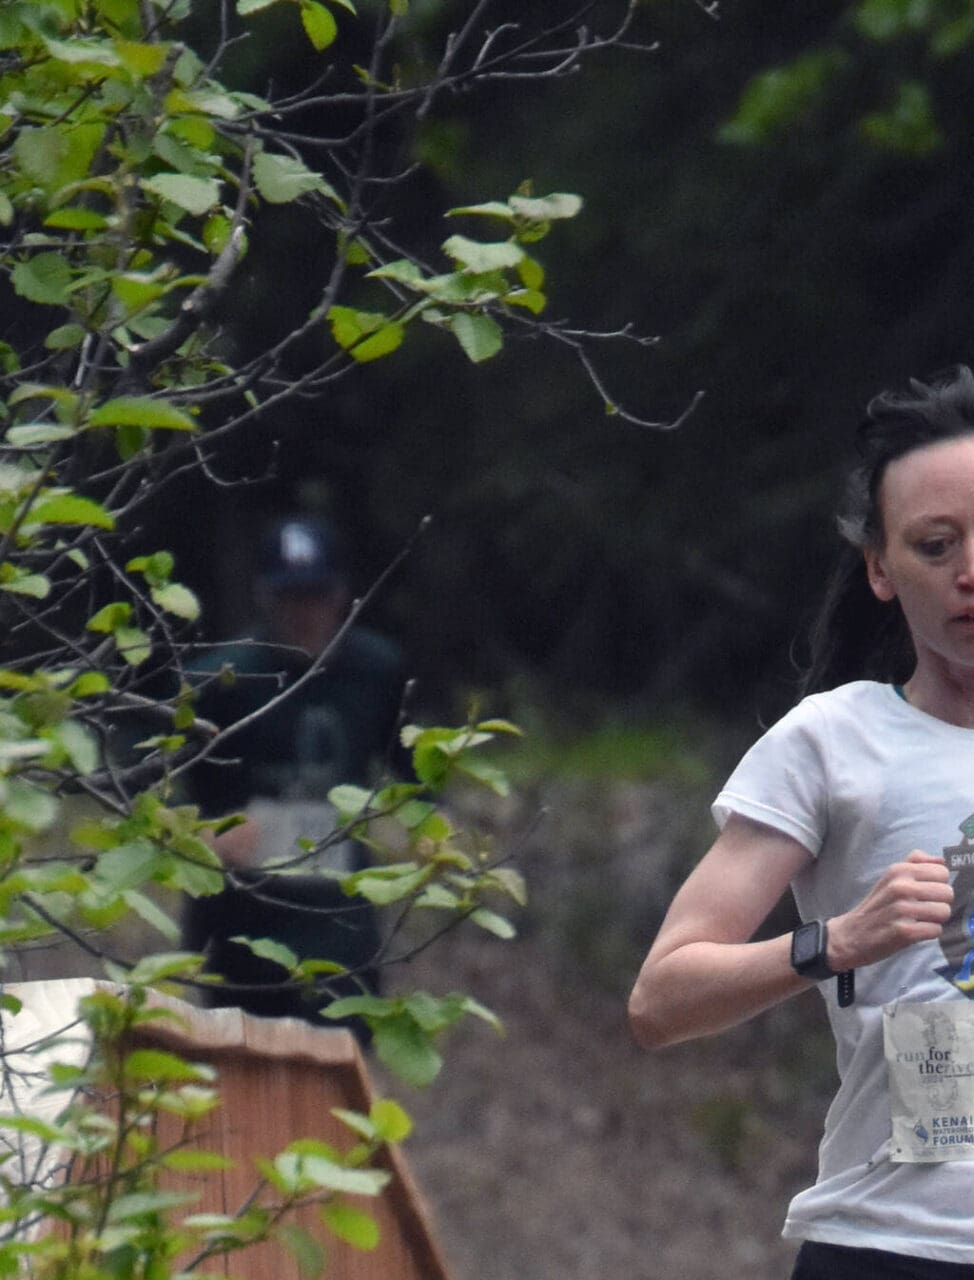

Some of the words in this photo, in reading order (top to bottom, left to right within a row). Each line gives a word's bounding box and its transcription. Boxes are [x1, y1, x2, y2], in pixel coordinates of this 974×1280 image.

[928, 1046, 951, 1061] for
[919, 1060, 944, 1075] the
[932, 1115, 973, 1128] KENAI
[933, 1135, 974, 1146] FORUM
